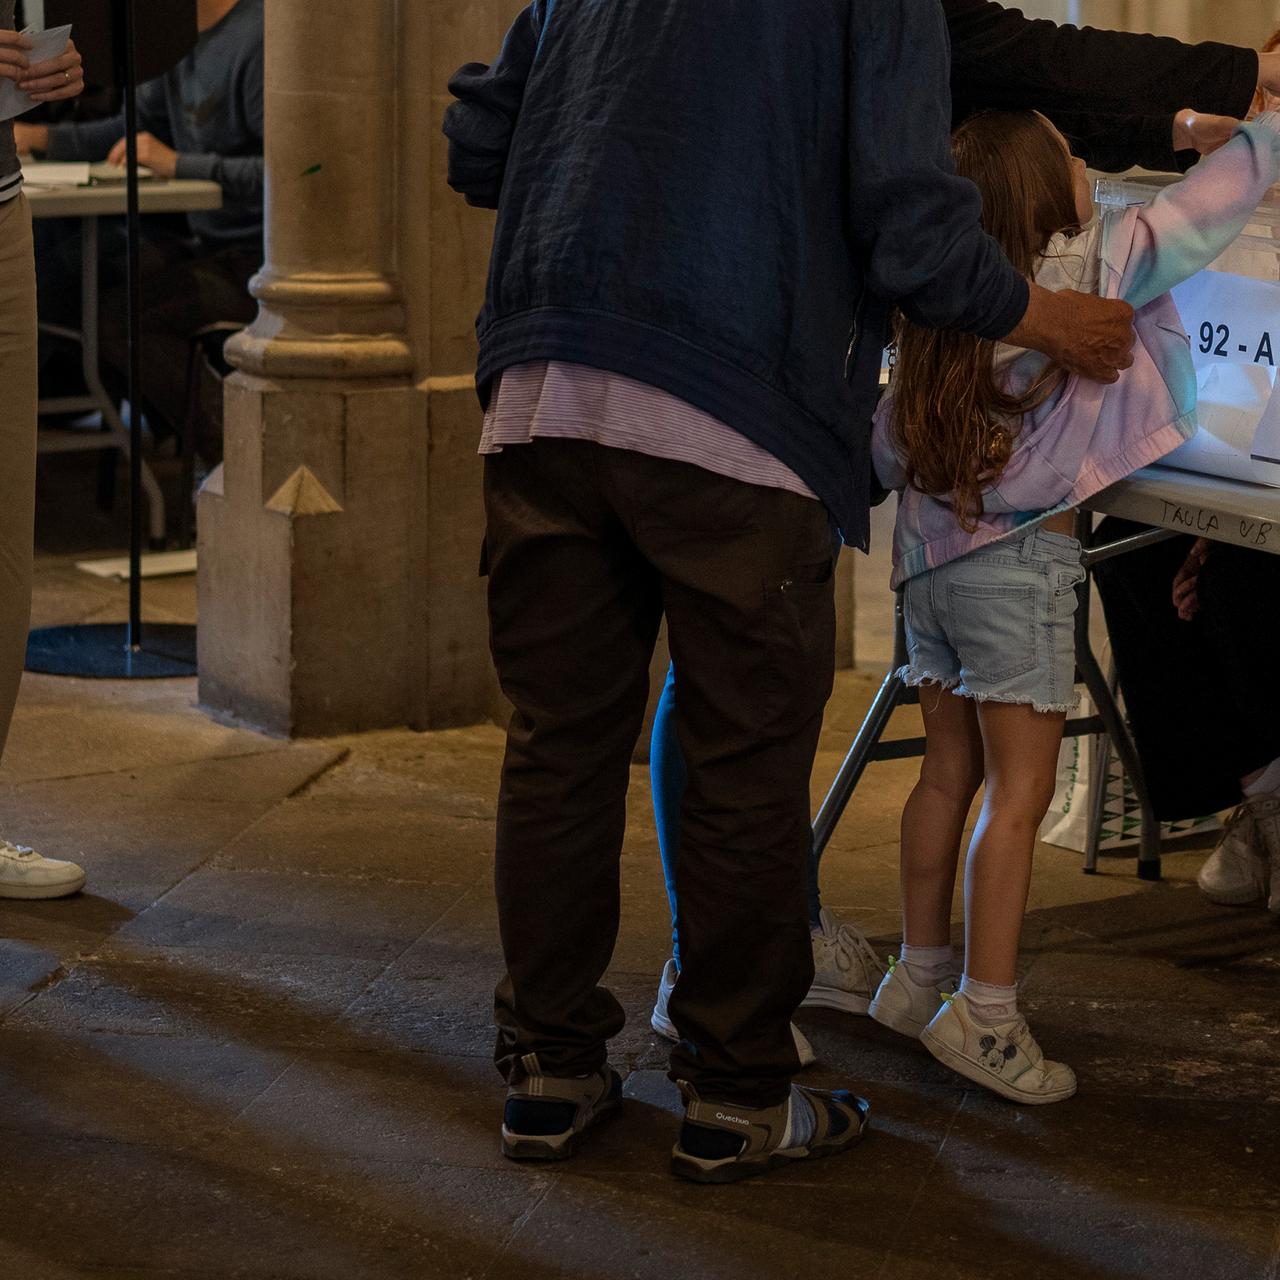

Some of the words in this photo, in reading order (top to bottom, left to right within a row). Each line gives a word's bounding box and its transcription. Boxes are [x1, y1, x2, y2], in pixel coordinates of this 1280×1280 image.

[1199, 321, 1230, 357] 92
[1253, 331, 1275, 366] A
[1160, 498, 1219, 533] TAULA
